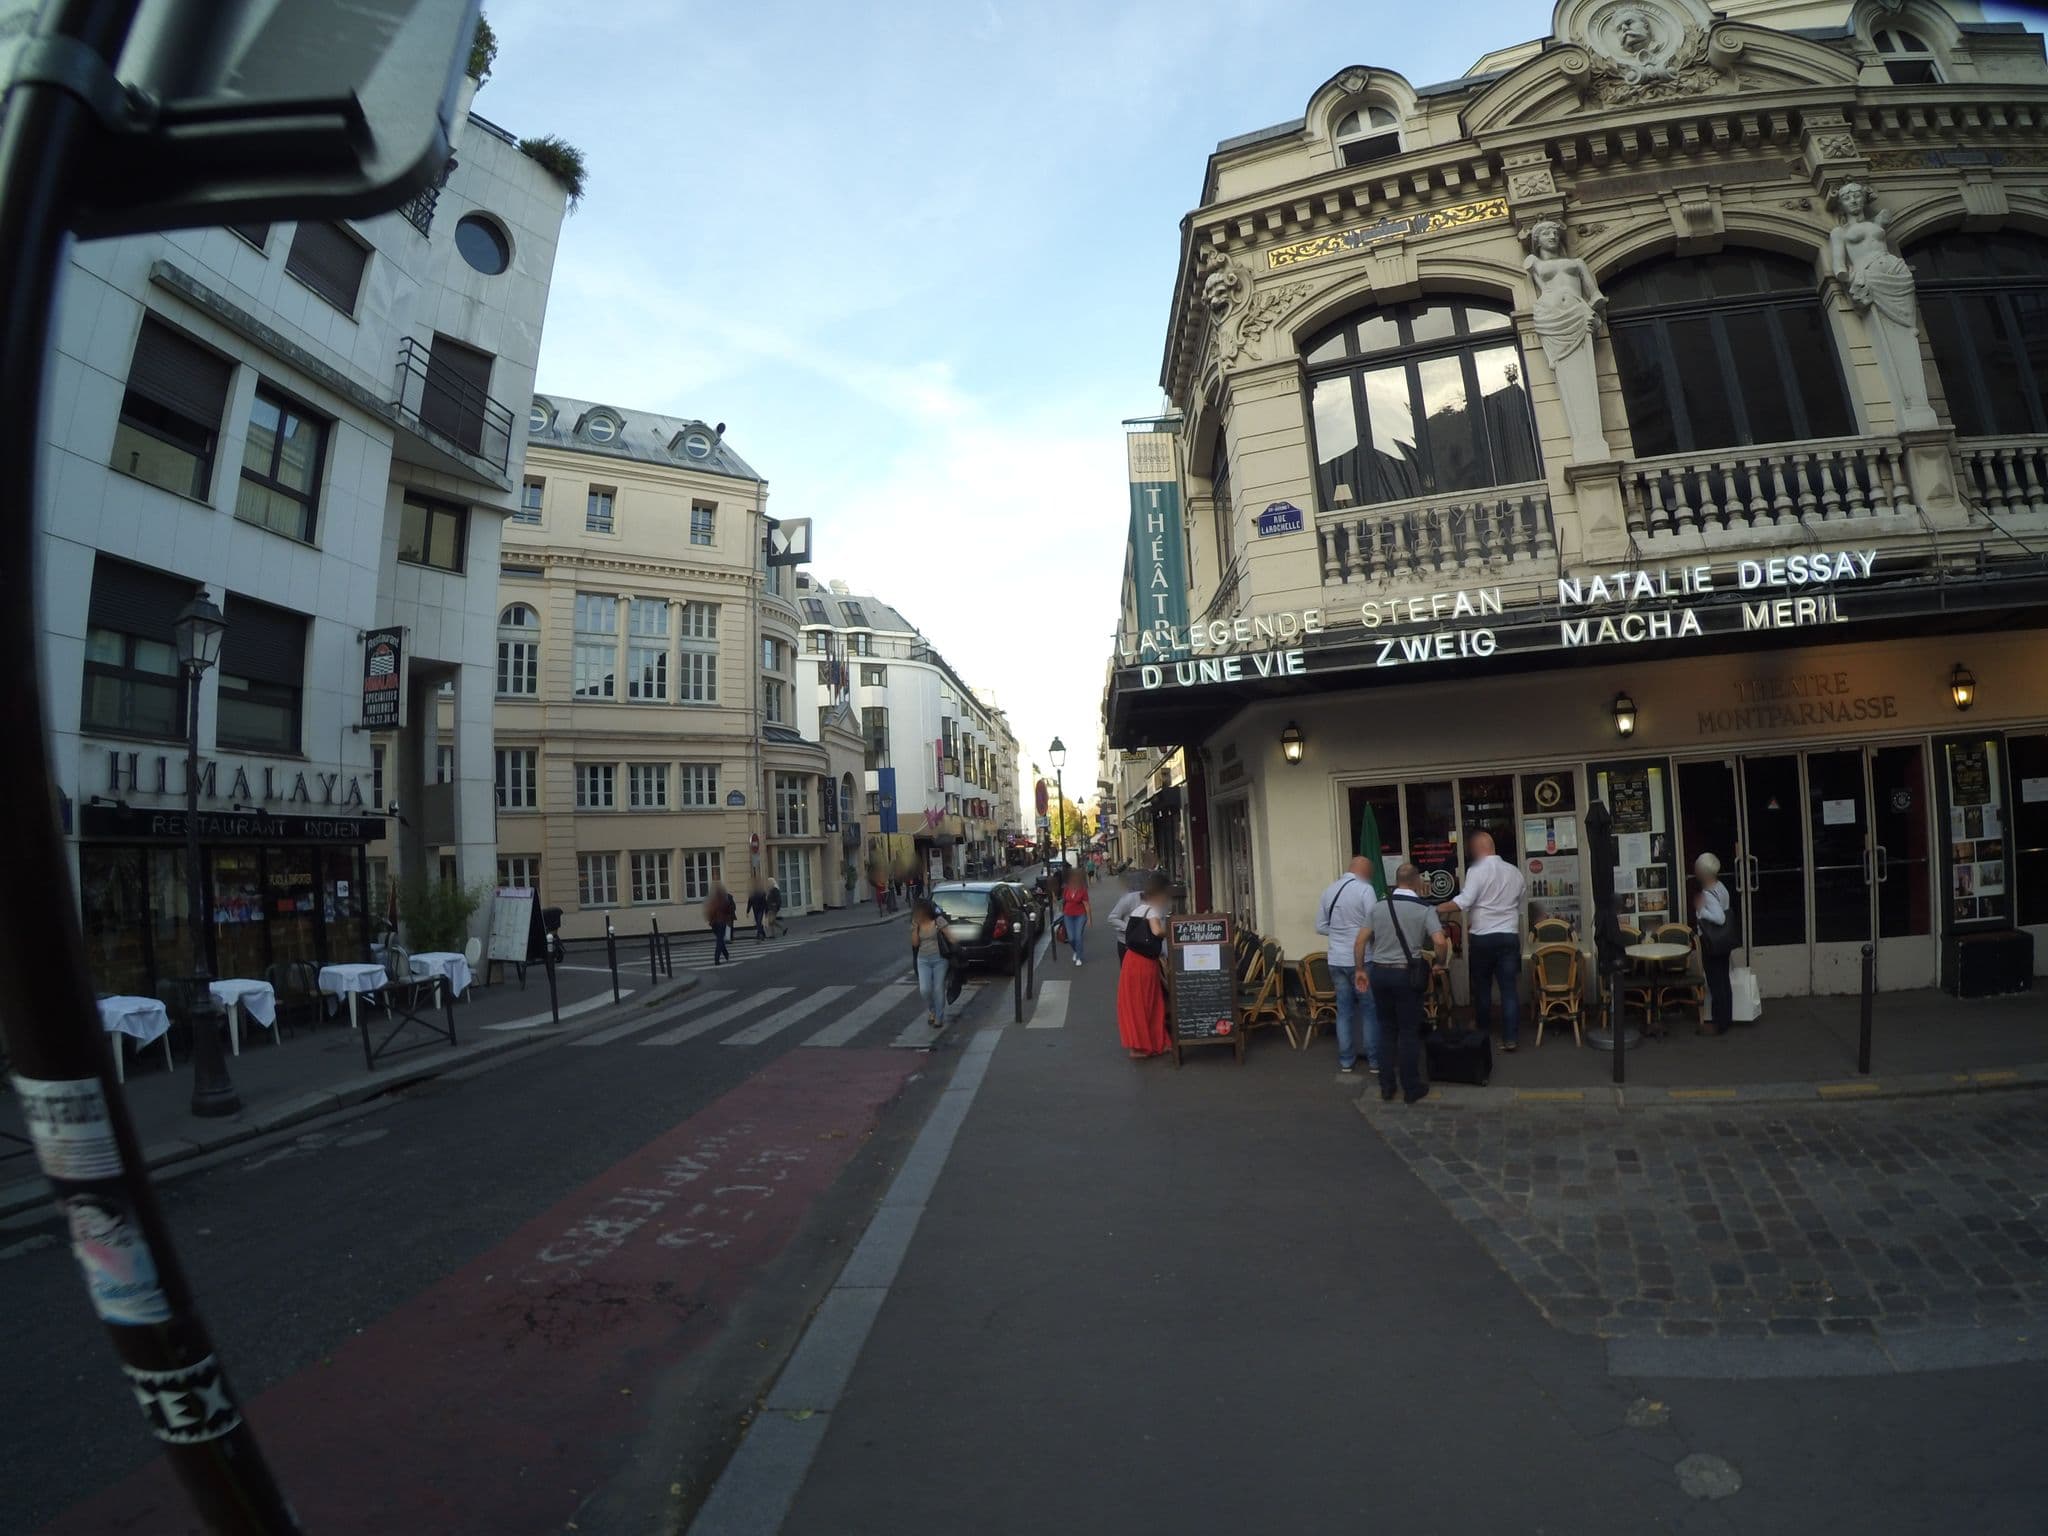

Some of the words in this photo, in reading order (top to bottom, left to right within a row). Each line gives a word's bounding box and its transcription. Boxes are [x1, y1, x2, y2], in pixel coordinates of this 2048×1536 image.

[1261, 520, 1301, 535] LAROCHELLE
[1273, 514, 1287, 524] RUE
[1558, 566, 1714, 606] NATALIE
[1738, 550, 1876, 589] DESSAY
[1361, 588, 1503, 628] STEFAN
[1560, 607, 1703, 648] MACHA
[1742, 594, 1849, 632] MERIL
[1119, 629, 1160, 657] LA
[1170, 609, 1324, 650] LEGENDE
[1375, 628, 1497, 668] ZWEIG
[1141, 664, 1164, 690] D
[1176, 655, 1243, 687] UNE
[1252, 648, 1307, 678] VIE
[1698, 696, 1898, 736] MONTPARNASSE
[107, 751, 365, 806] HIMALAYA
[825, 779, 834, 824] HOTEL
[304, 820, 360, 838] INDIEN
